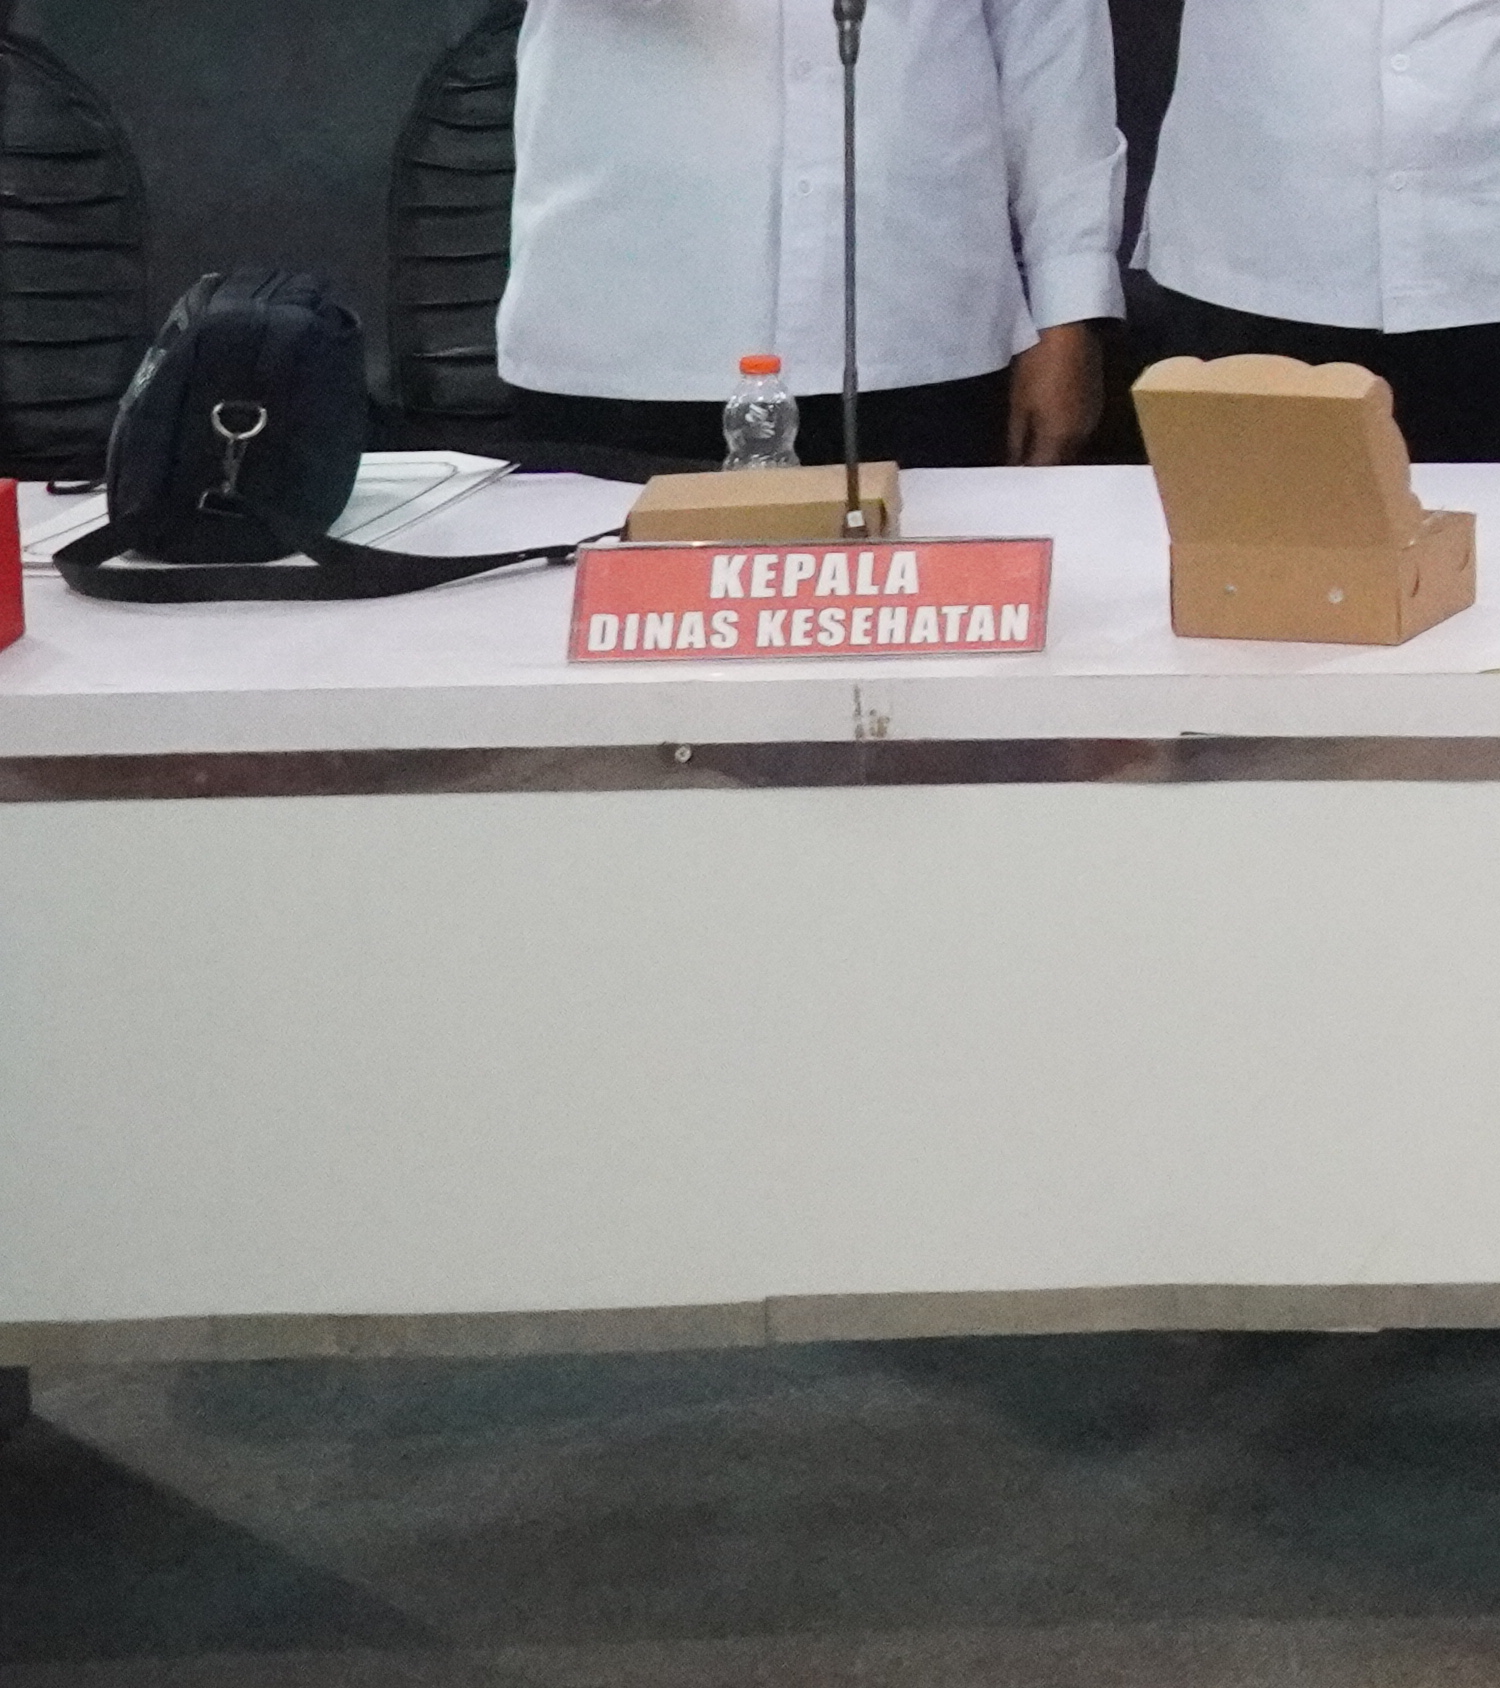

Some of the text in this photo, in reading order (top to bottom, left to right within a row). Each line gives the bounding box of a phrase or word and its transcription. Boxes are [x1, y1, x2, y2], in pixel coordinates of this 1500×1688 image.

[709, 551, 919, 598] KEPALA
[587, 603, 1030, 651] DINAS KESEHATAN
